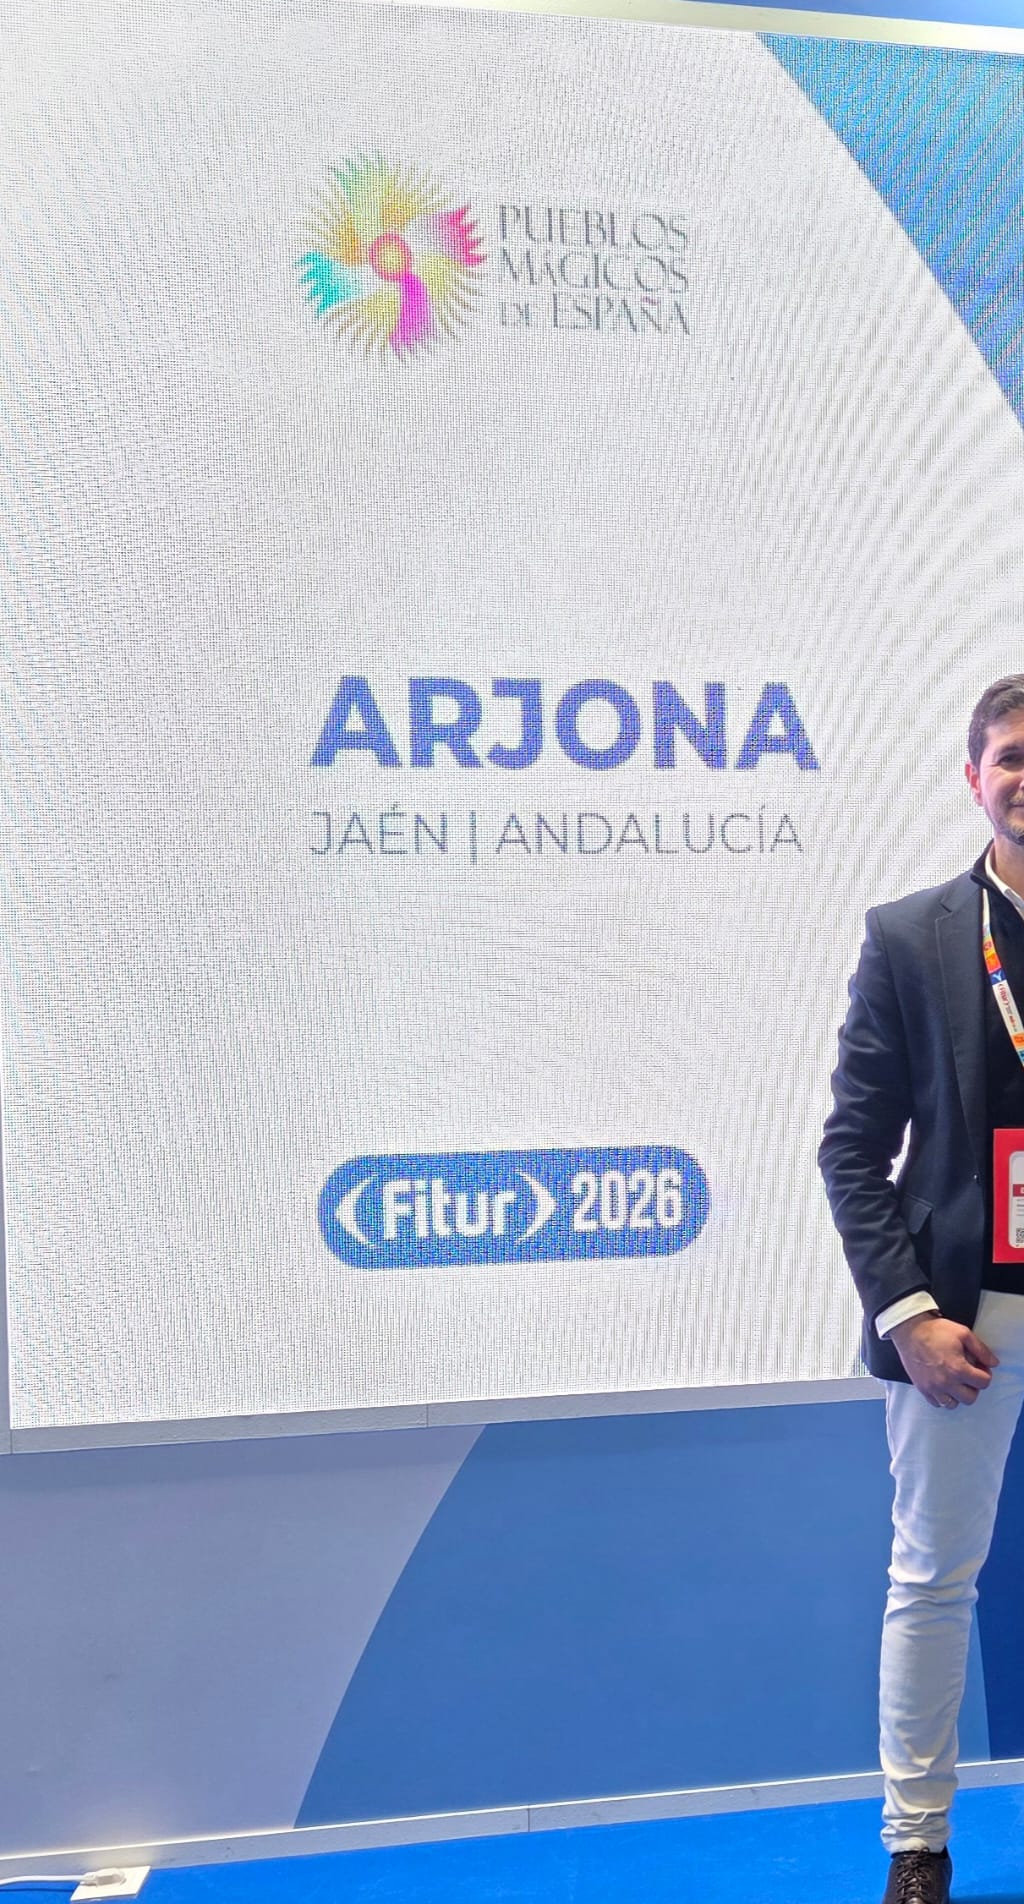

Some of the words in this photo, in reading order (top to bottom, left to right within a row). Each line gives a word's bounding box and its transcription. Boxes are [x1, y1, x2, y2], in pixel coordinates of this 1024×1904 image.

[500, 204, 688, 251] PUEBLOS
[501, 302, 530, 327] DE
[553, 292, 690, 335] ESPAÑA
[310, 675, 821, 771] ARJONA
[311, 803, 447, 855] JAÉN
[496, 805, 804, 855] ANDALUCÍA
[382, 1177, 514, 1241] Fitur
[571, 1170, 683, 1232] 2026
